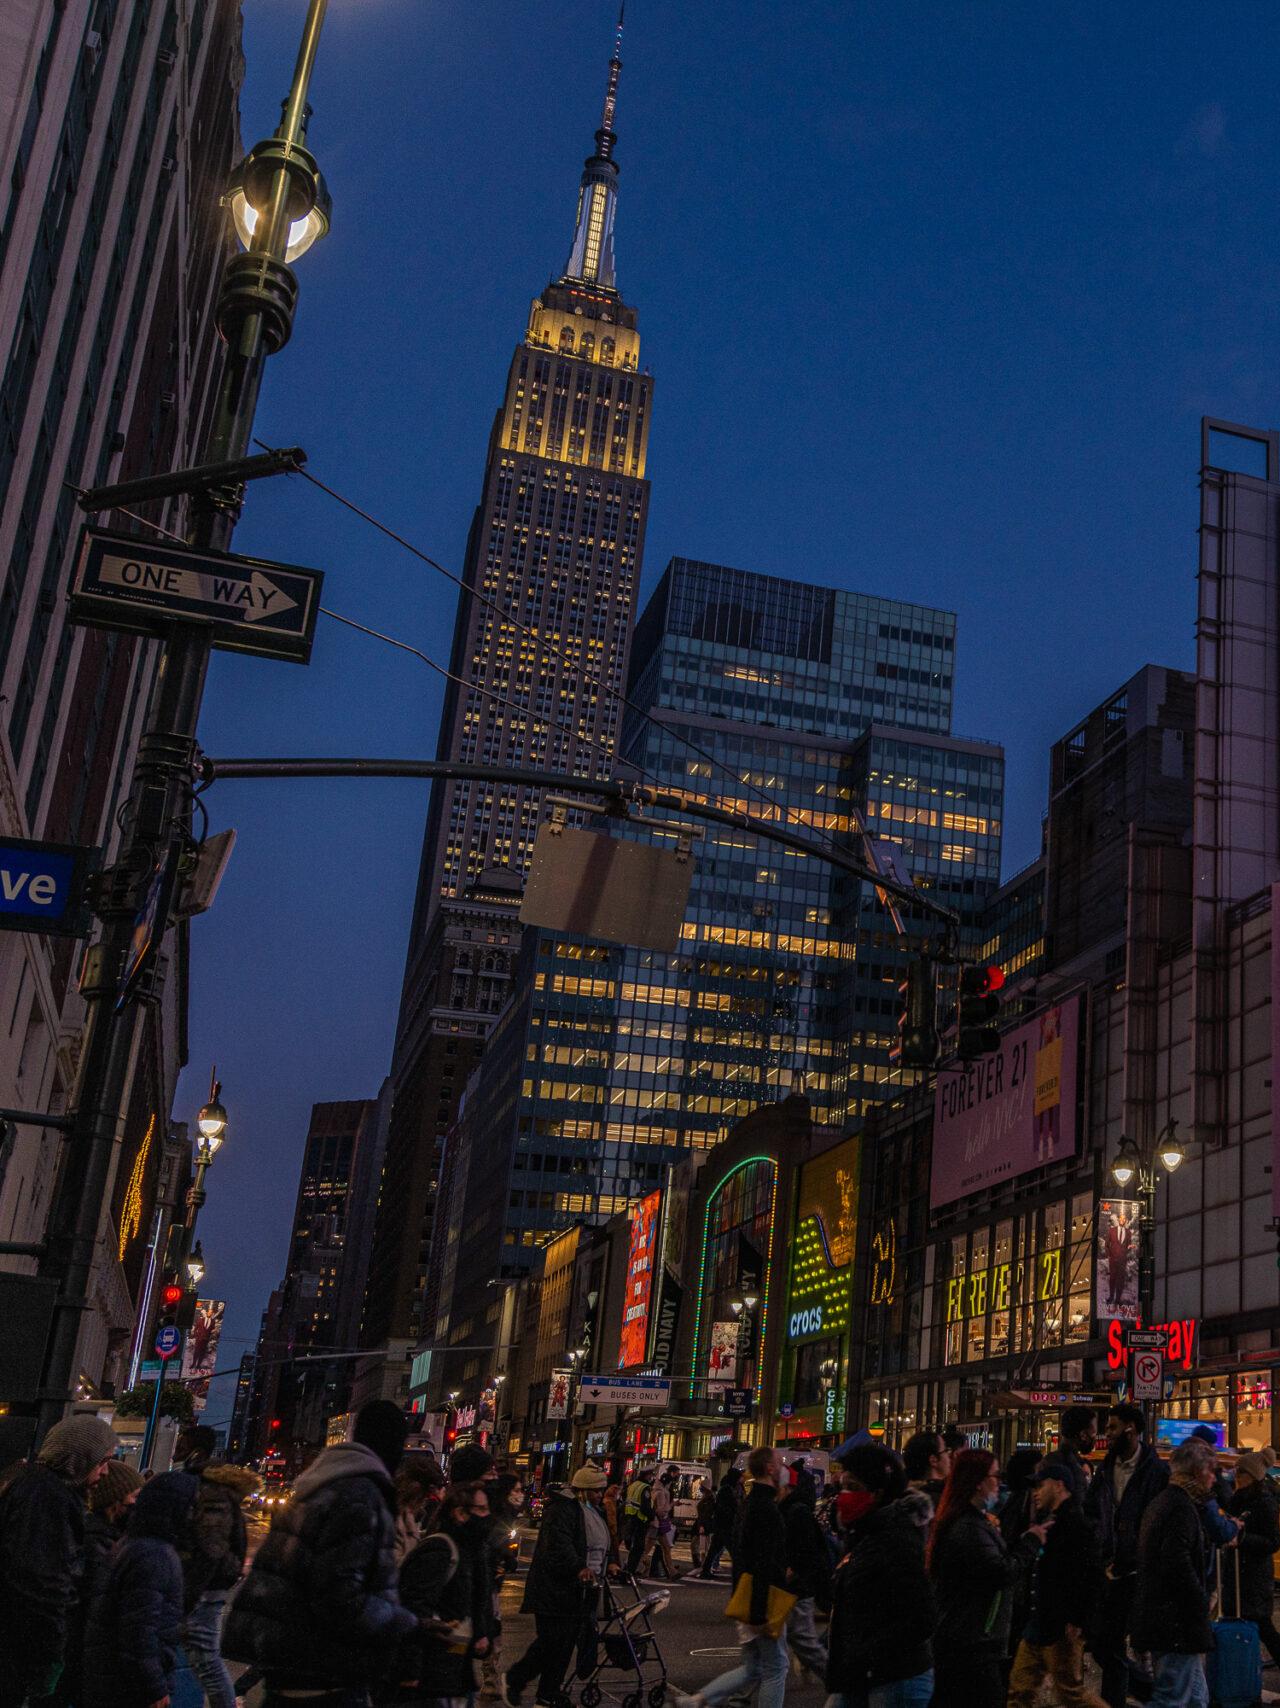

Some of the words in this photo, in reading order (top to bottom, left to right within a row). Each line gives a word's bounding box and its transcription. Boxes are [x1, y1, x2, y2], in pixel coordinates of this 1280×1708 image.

[122, 562, 182, 593] ONE
[213, 578, 278, 609] WAY
[941, 1053, 1005, 1123] FOREVER
[1012, 1040, 1028, 1088] 21
[1042, 1249, 1061, 1301] 21
[661, 1299, 677, 1332] NAVY
[790, 1306, 823, 1337] crocs
[655, 1342, 671, 1373] OLD
[1107, 1315, 1195, 1370] Say
[610, 1391, 637, 1400] BUSES
[639, 1391, 660, 1401] ONLY
[1072, 1394, 1093, 1402] Subway
